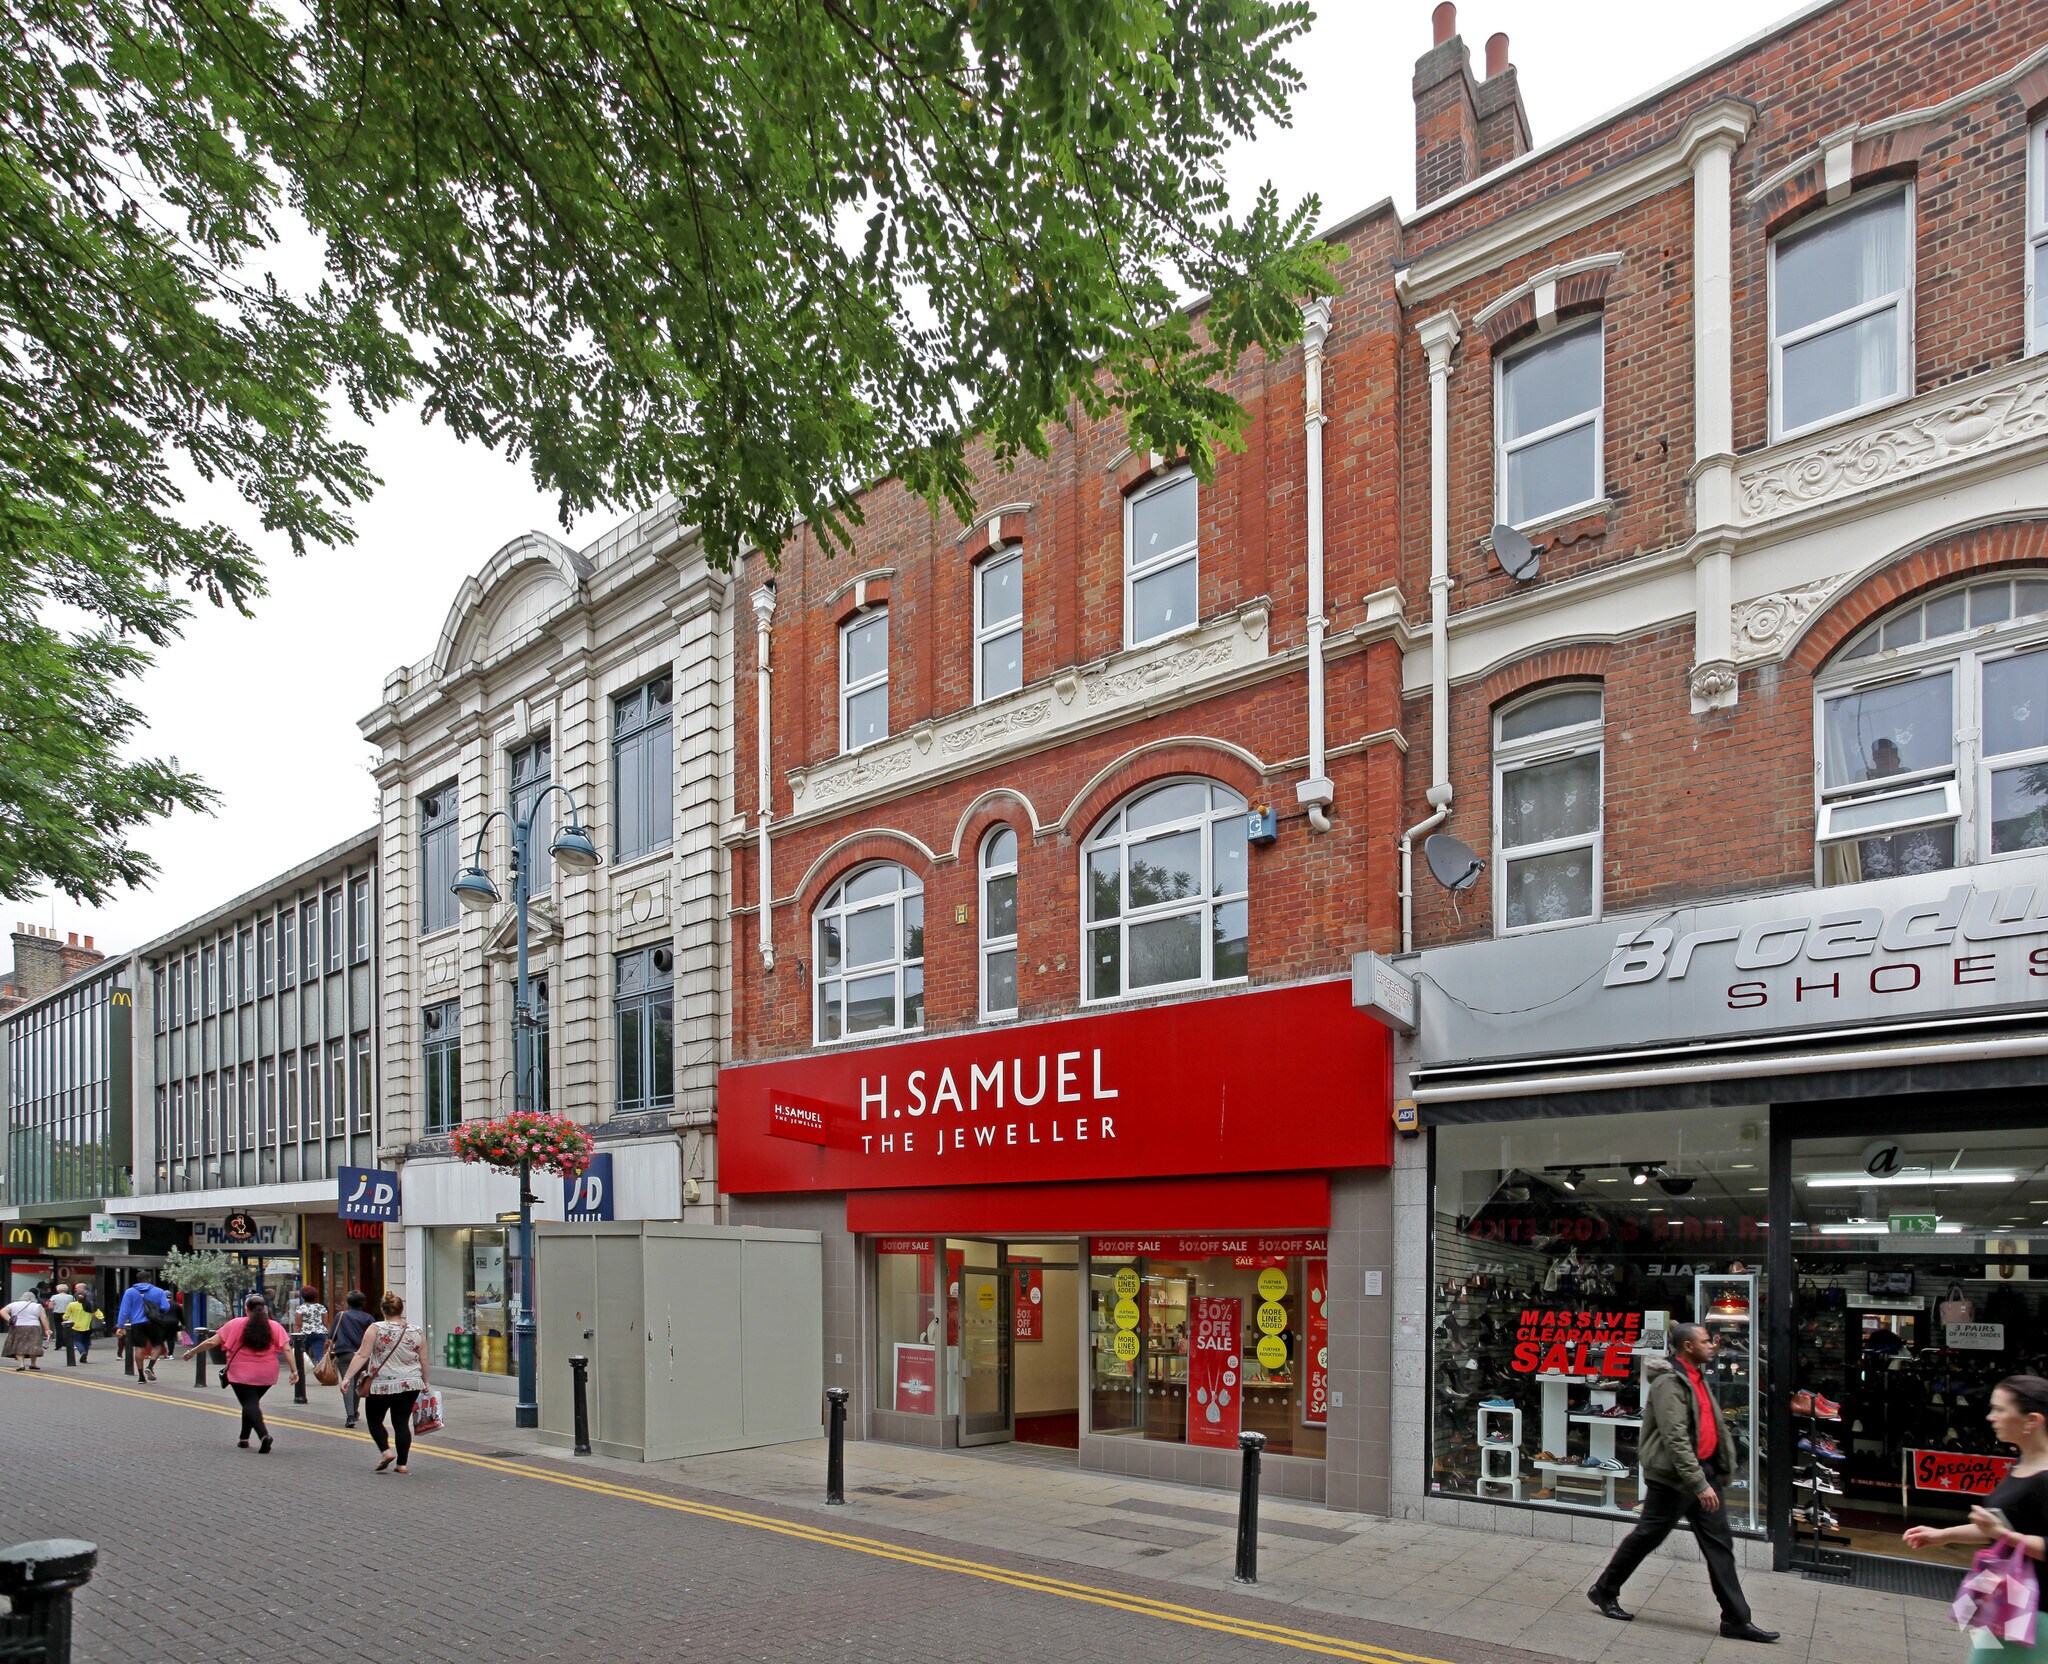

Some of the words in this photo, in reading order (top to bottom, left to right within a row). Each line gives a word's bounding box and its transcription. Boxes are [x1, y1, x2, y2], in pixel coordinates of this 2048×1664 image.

[1376, 970, 1413, 1006] Broadway
[1399, 1111, 1415, 1120] ADT
[790, 1119, 822, 1129] JEWELLER
[861, 1132, 914, 1155] THE
[937, 1116, 1116, 1156] JEWELLER
[346, 1203, 391, 1215] SPORTS
[911, 1241, 929, 1251] SALE
[1137, 1241, 1160, 1251] SALE
[1221, 1241, 1247, 1252] SALE
[1305, 1240, 1327, 1251] SAL
[1235, 1257, 1254, 1266] SALE
[1016, 1310, 1031, 1319] 50%
[1198, 1303, 1232, 1320] 50%
[1261, 1308, 1282, 1316] MORE
[1018, 1319, 1031, 1328] OFF
[1261, 1315, 1282, 1323] LINES
[1519, 1309, 1641, 1329] MASSIVE
[1016, 1327, 1032, 1336] SALE
[1199, 1319, 1231, 1337] OFF
[1516, 1327, 1640, 1346] CLEARANCE
[1197, 1336, 1232, 1352] SALE
[1510, 1341, 1632, 1378] SALE
[1919, 1455, 1993, 1483] Special
